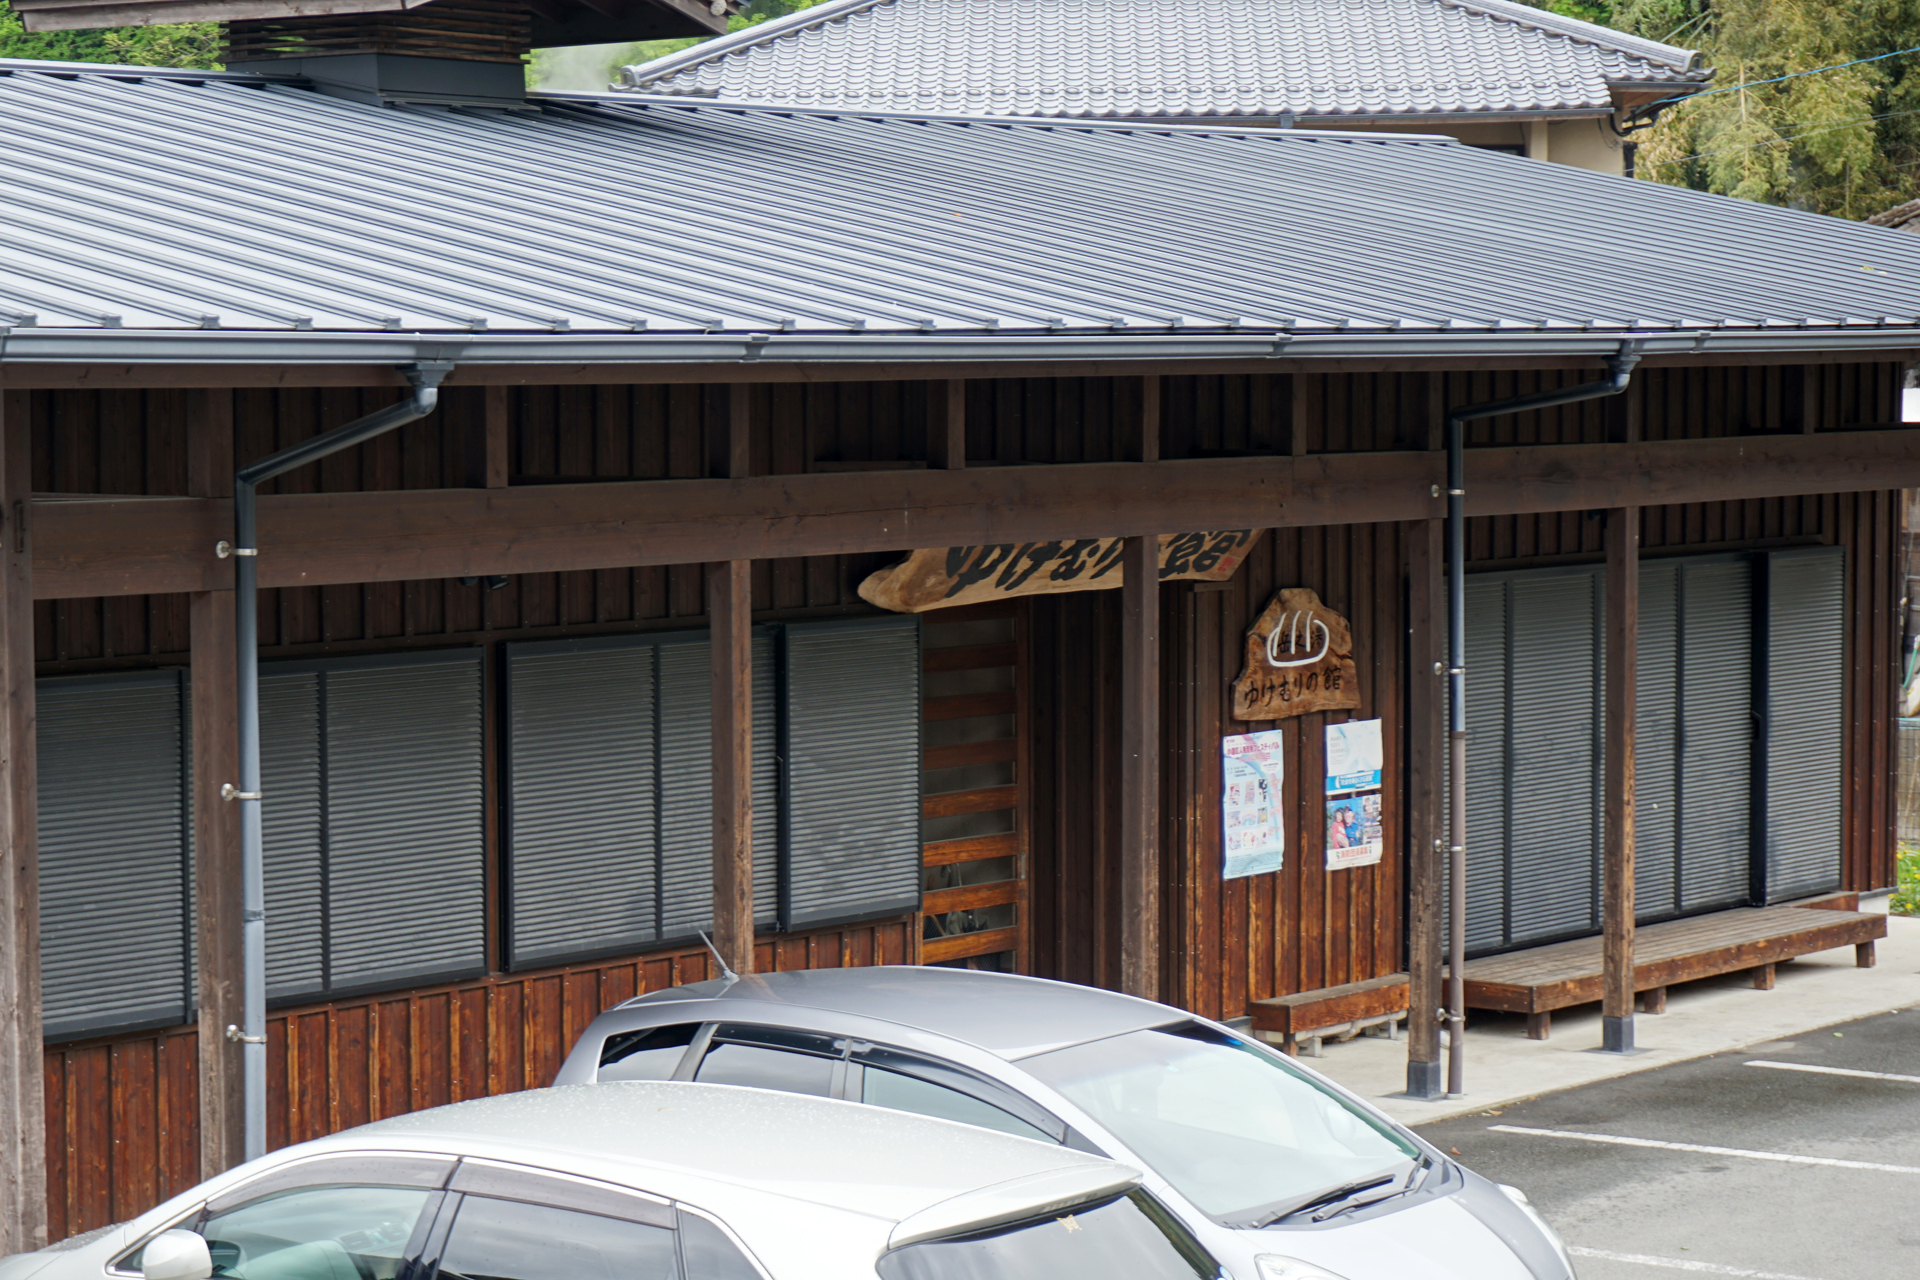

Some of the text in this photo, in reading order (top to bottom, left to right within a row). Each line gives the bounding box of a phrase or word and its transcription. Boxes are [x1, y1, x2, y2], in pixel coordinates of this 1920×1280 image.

[944, 528, 1253, 598] ゆけむり館
[1243, 665, 1342, 710] ゆけむりの館
